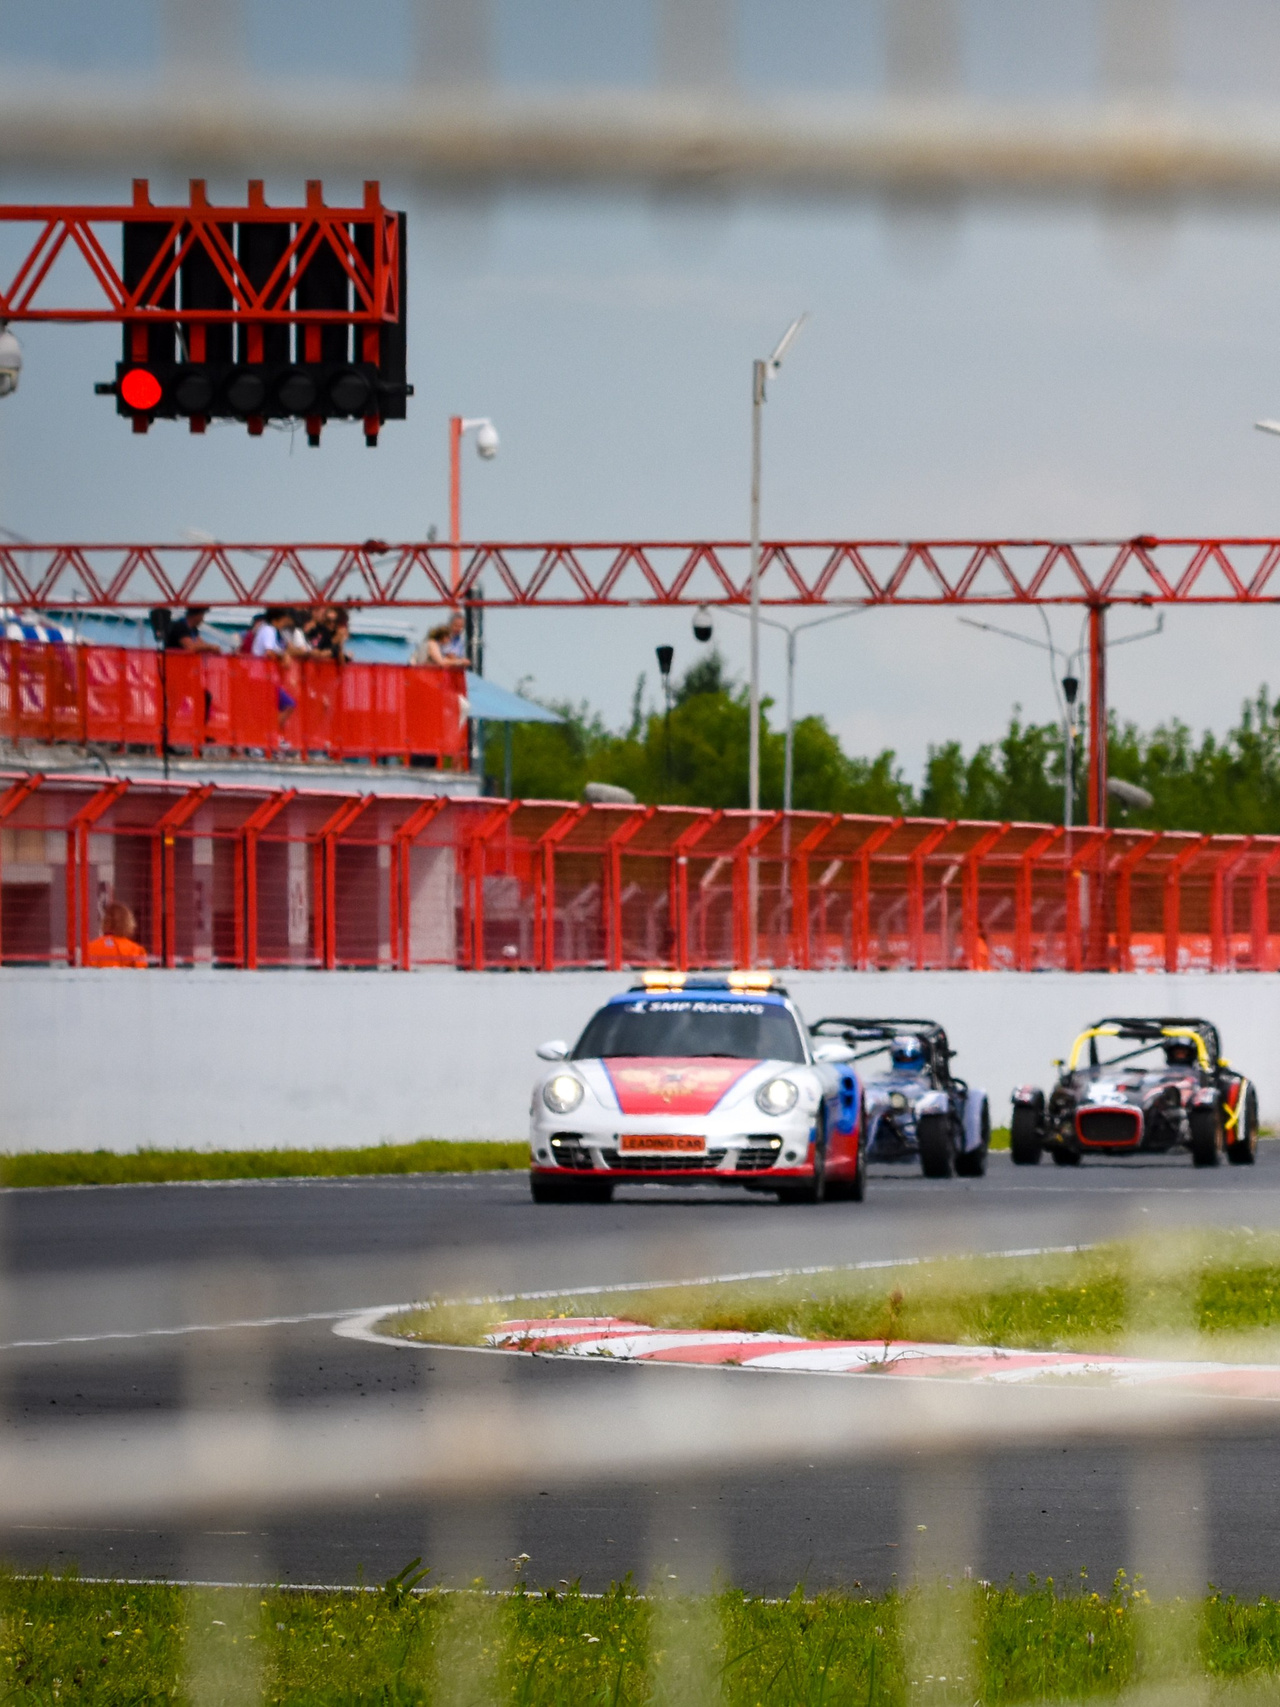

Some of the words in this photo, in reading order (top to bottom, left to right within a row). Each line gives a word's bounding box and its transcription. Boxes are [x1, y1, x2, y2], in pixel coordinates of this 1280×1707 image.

[649, 1001, 691, 1013] SMP
[692, 1001, 764, 1015] RACING
[623, 1138, 675, 1149] LEADING
[677, 1138, 702, 1149] CAR
